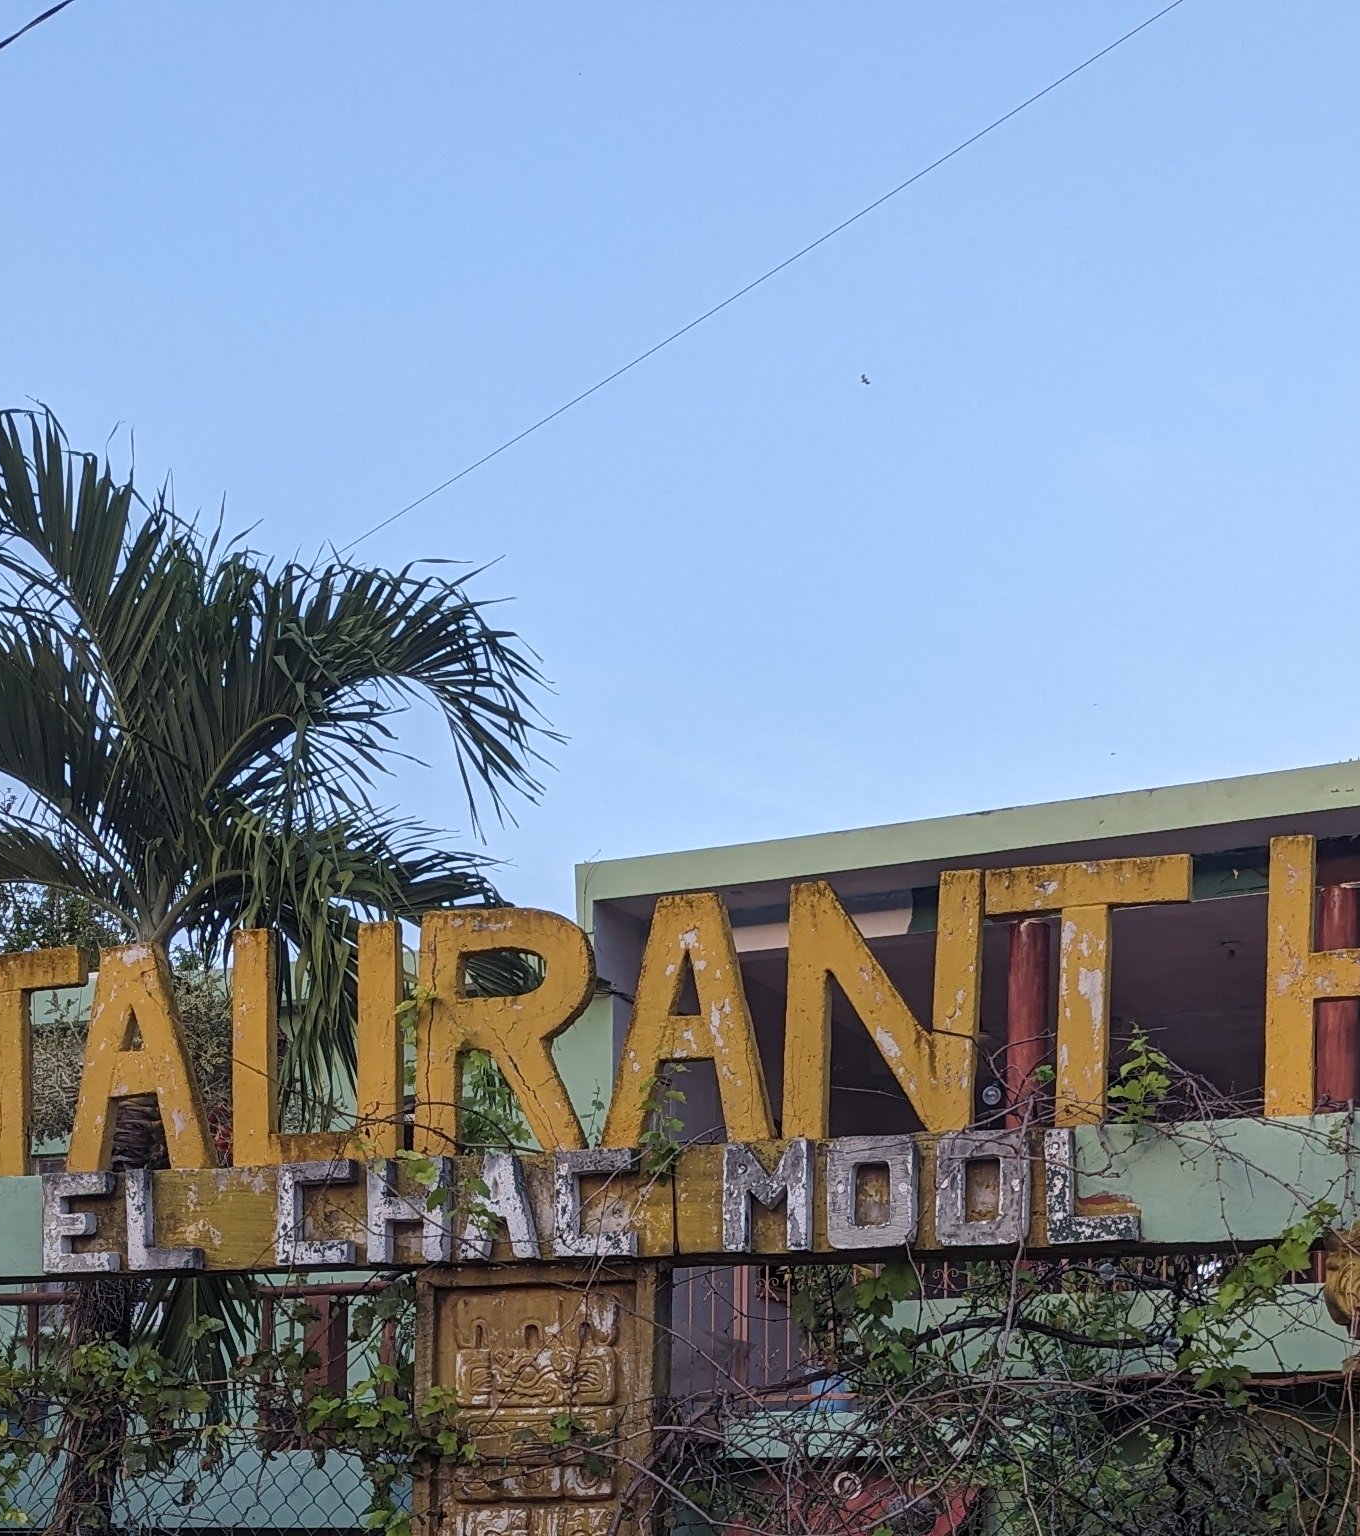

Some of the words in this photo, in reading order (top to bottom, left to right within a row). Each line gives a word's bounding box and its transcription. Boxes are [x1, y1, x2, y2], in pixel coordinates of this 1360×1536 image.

[42, 1168, 205, 1274] EL
[274, 1148, 639, 1266] CHAC
[722, 1127, 1142, 1253] MOOL
